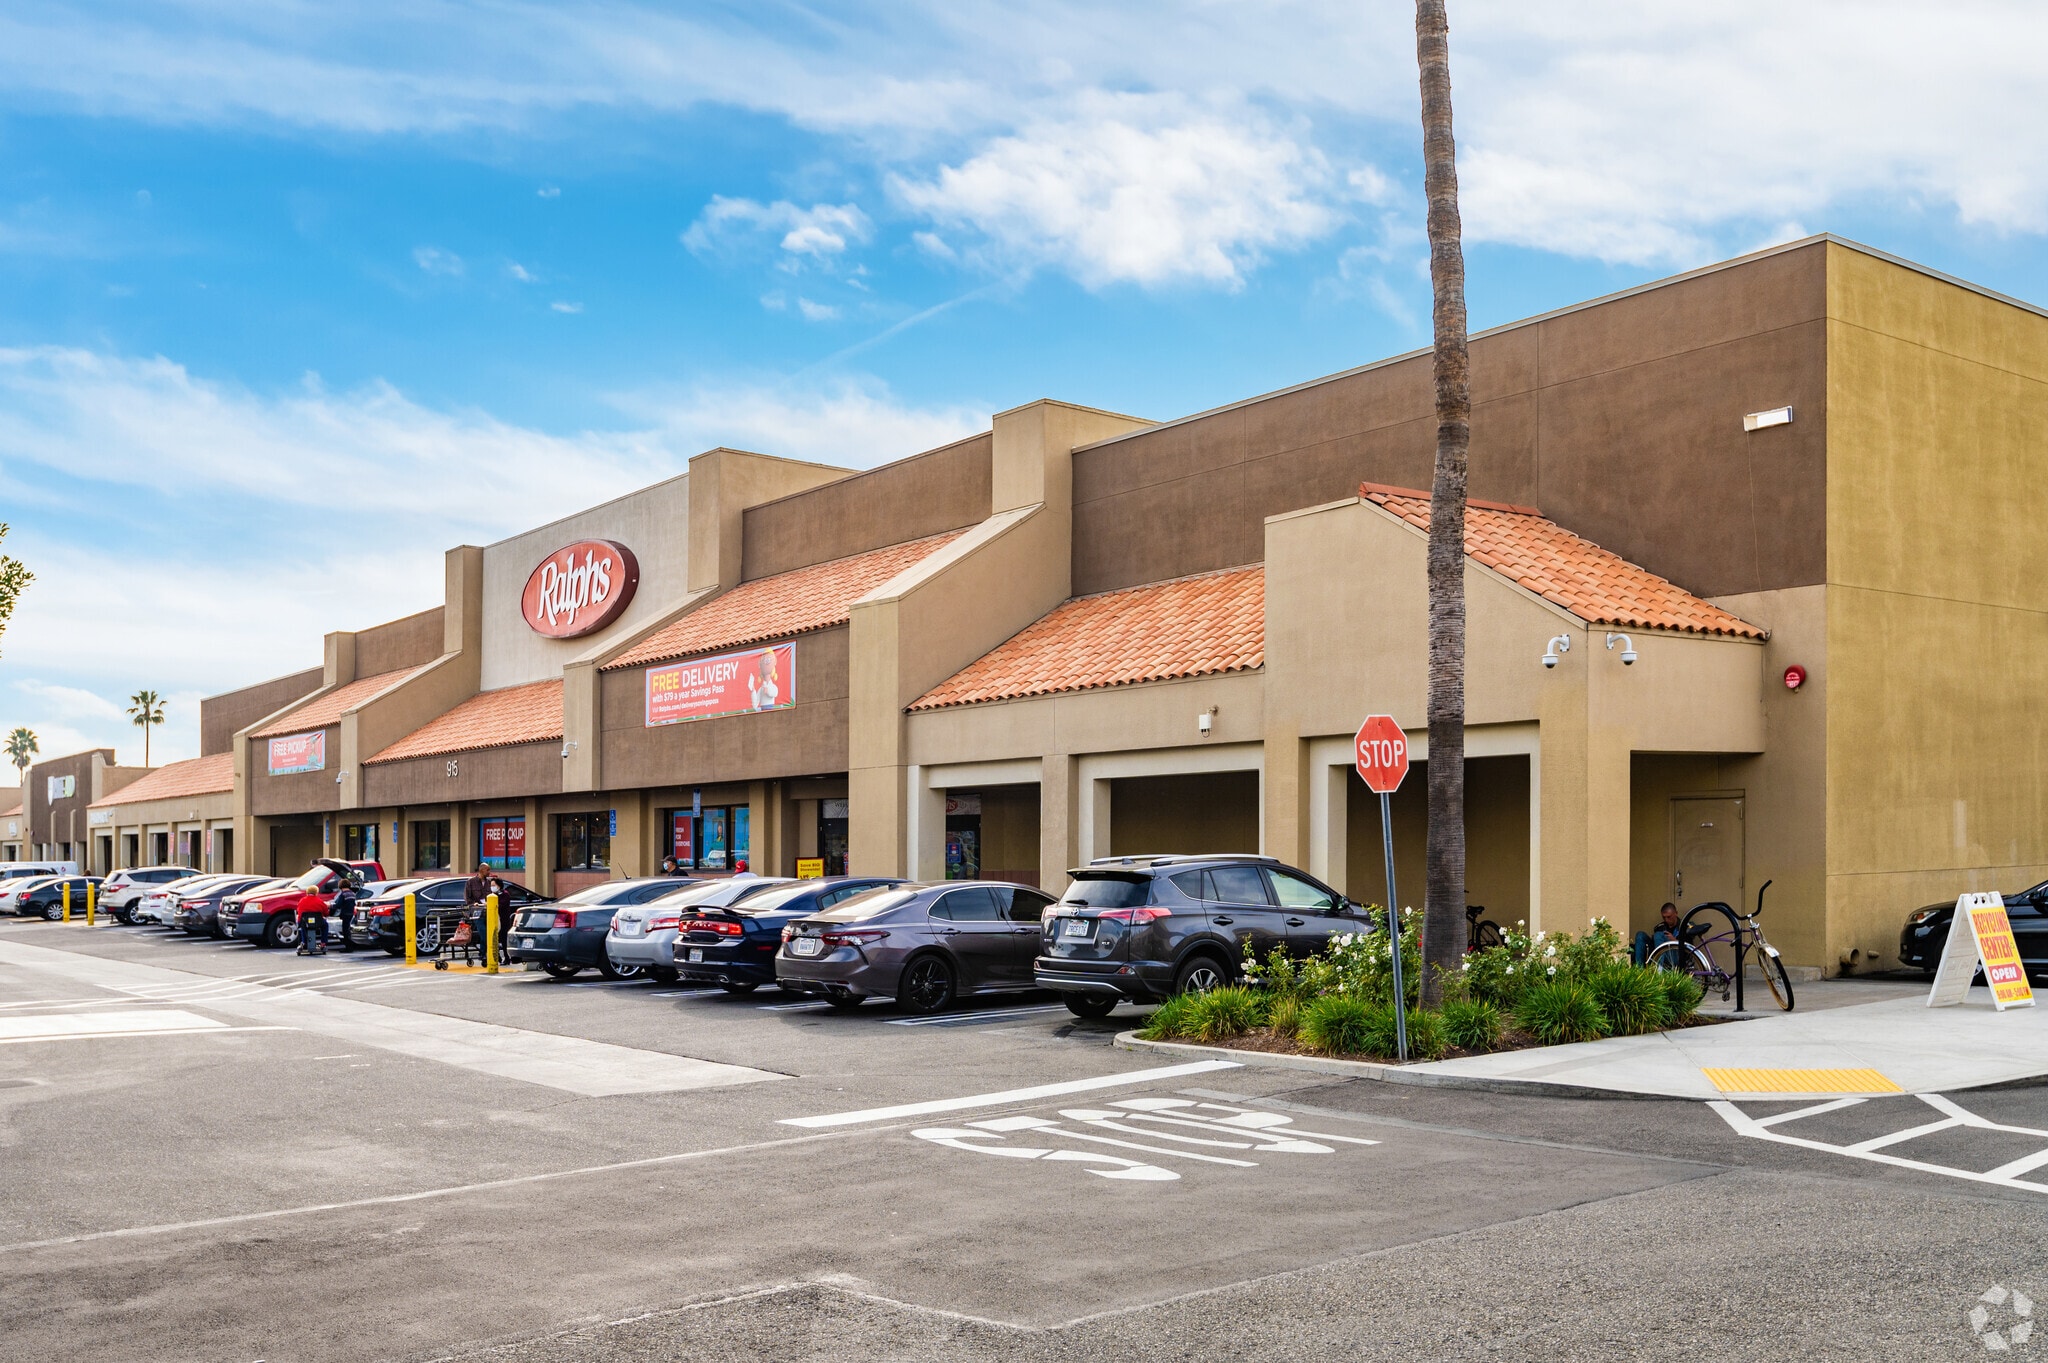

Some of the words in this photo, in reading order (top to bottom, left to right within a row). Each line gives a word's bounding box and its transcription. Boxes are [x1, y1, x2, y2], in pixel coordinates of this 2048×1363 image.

[537, 549, 612, 626] Ralphs
[653, 672, 679, 692] FREE
[682, 662, 739, 688] DELIVERY
[652, 694, 663, 703] with
[664, 692, 673, 702] $79
[678, 690, 690, 700] year
[691, 686, 711, 697] Savings
[712, 685, 724, 694] Pass
[274, 742, 287, 756] FREE
[288, 740, 306, 754] PICKUP
[1360, 739, 1404, 769] STOP
[447, 760, 458, 777] 915
[486, 828, 501, 840] FREE
[501, 827, 524, 840] PCKUP
[1972, 911, 2009, 934] RECYCLING
[1980, 935, 2013, 960] CENTER
[1991, 967, 2017, 980] OPEN
[910, 1097, 1382, 1181] STOP
